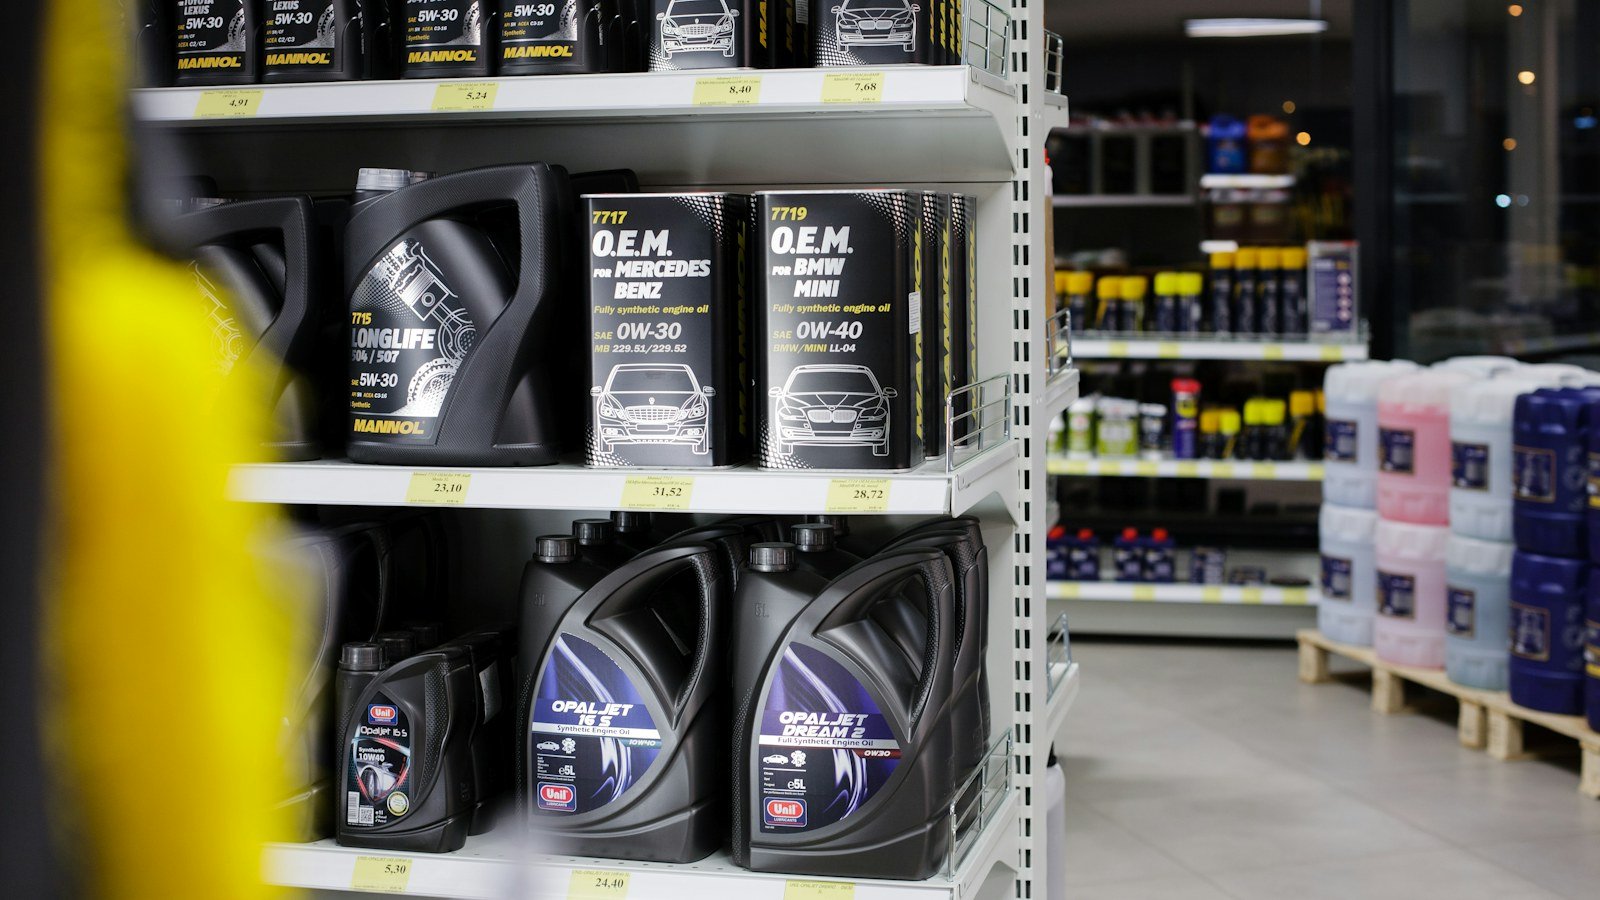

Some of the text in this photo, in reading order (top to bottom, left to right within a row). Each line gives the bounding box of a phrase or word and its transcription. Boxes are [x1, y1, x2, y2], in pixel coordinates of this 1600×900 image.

[184, 5, 209, 15] LEXUS
[273, 1, 299, 10] LEXUS
[514, 4, 555, 17] 5W-30
[275, 12, 313, 25] 5W-30
[418, 9, 458, 22] 5W-30
[186, 17, 223, 29] 5W-30
[408, 34, 430, 42] Synthetic
[504, 29, 526, 37] Synthetic
[408, 51, 476, 63] MANNOL
[504, 46, 573, 59] MANNOL
[178, 56, 241, 69] MANNOL
[266, 53, 330, 66] MANNOL
[729, 86, 751, 94] 8,40
[855, 83, 877, 91] 7,68
[466, 92, 487, 100] 5,24
[230, 99, 248, 107] 4,91
[592, 210, 627, 224] 7717
[771, 207, 808, 220] 7719
[592, 230, 673, 258] O.E.M.
[771, 226, 854, 254] O.E.M.
[593, 260, 711, 278] FOR MERCEDES
[772, 258, 846, 276] FOR BMW
[614, 281, 663, 300] BENZ
[794, 280, 840, 298] MINI
[594, 304, 709, 316] Fully synthetic engine oil
[773, 303, 891, 314] Fully synthetic engine oil
[352, 312, 372, 325] 7715
[594, 322, 682, 340] SAE 0W-30
[773, 321, 863, 340] SAE 0W-40
[351, 328, 437, 350] LONGLIFE
[594, 344, 687, 354] MB 229.51/229.52
[773, 344, 857, 354] BMW/MINI LL-04
[377, 350, 400, 363] 507
[360, 373, 398, 387] 5W-30
[354, 419, 424, 434] MANNOL
[434, 483, 462, 492] 23,10
[652, 487, 682, 497] 31,52
[853, 490, 883, 499] 28,72
[375, 708, 391, 717] Unil
[552, 700, 634, 717] OPALJET
[578, 714, 613, 727] 16 S
[779, 711, 869, 727] OPALJET
[360, 726, 408, 737] Opaljet 16 S
[557, 725, 590, 734] Synthetic
[782, 725, 866, 739] DREAM 2
[629, 739, 656, 747] 10W40
[794, 737, 830, 746] Synthetic
[832, 739, 860, 747] Engine
[358, 753, 385, 762] 10W40
[546, 788, 567, 800] Unil
[773, 803, 796, 815] Unil
[384, 864, 406, 874] 5,30
[595, 878, 624, 889] 24,40
